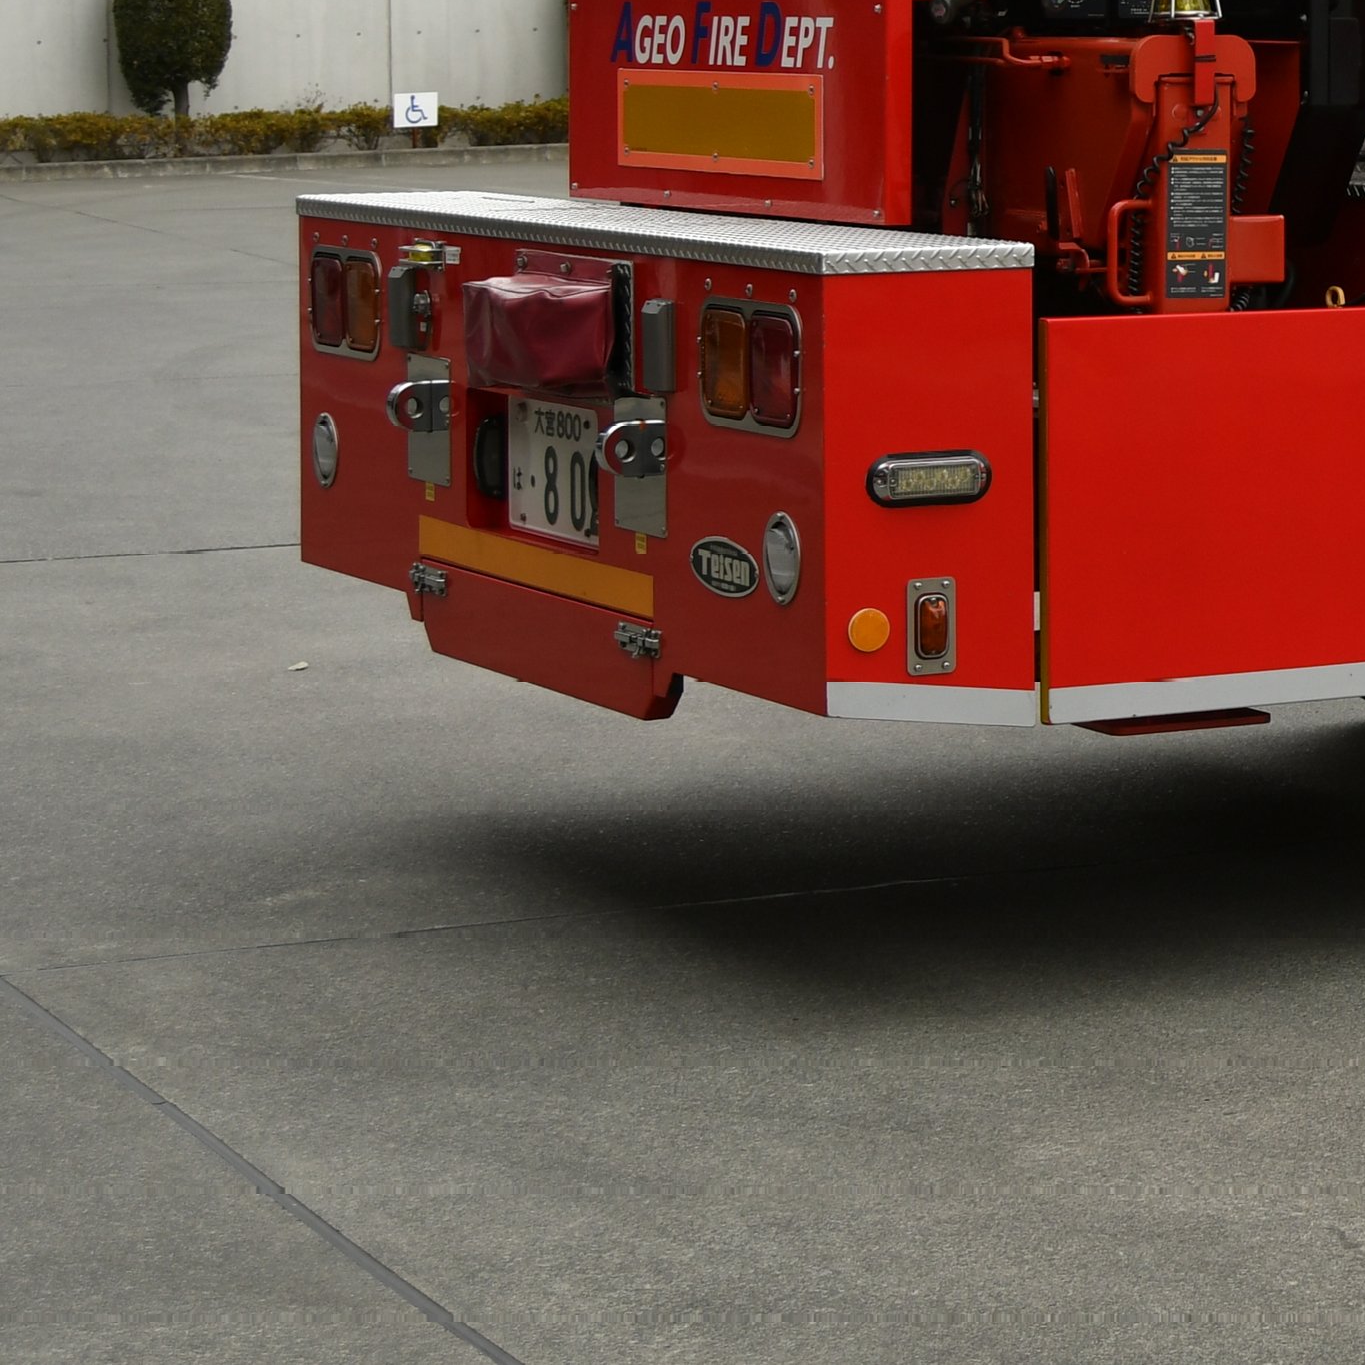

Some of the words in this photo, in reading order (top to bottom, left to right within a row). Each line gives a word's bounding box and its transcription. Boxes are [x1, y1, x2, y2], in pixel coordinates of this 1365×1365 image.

[610, 1, 686, 65] AGEO
[691, 1, 750, 66] FIRE
[755, 1, 834, 69] DEPT.
[698, 548, 750, 587] Teisen
